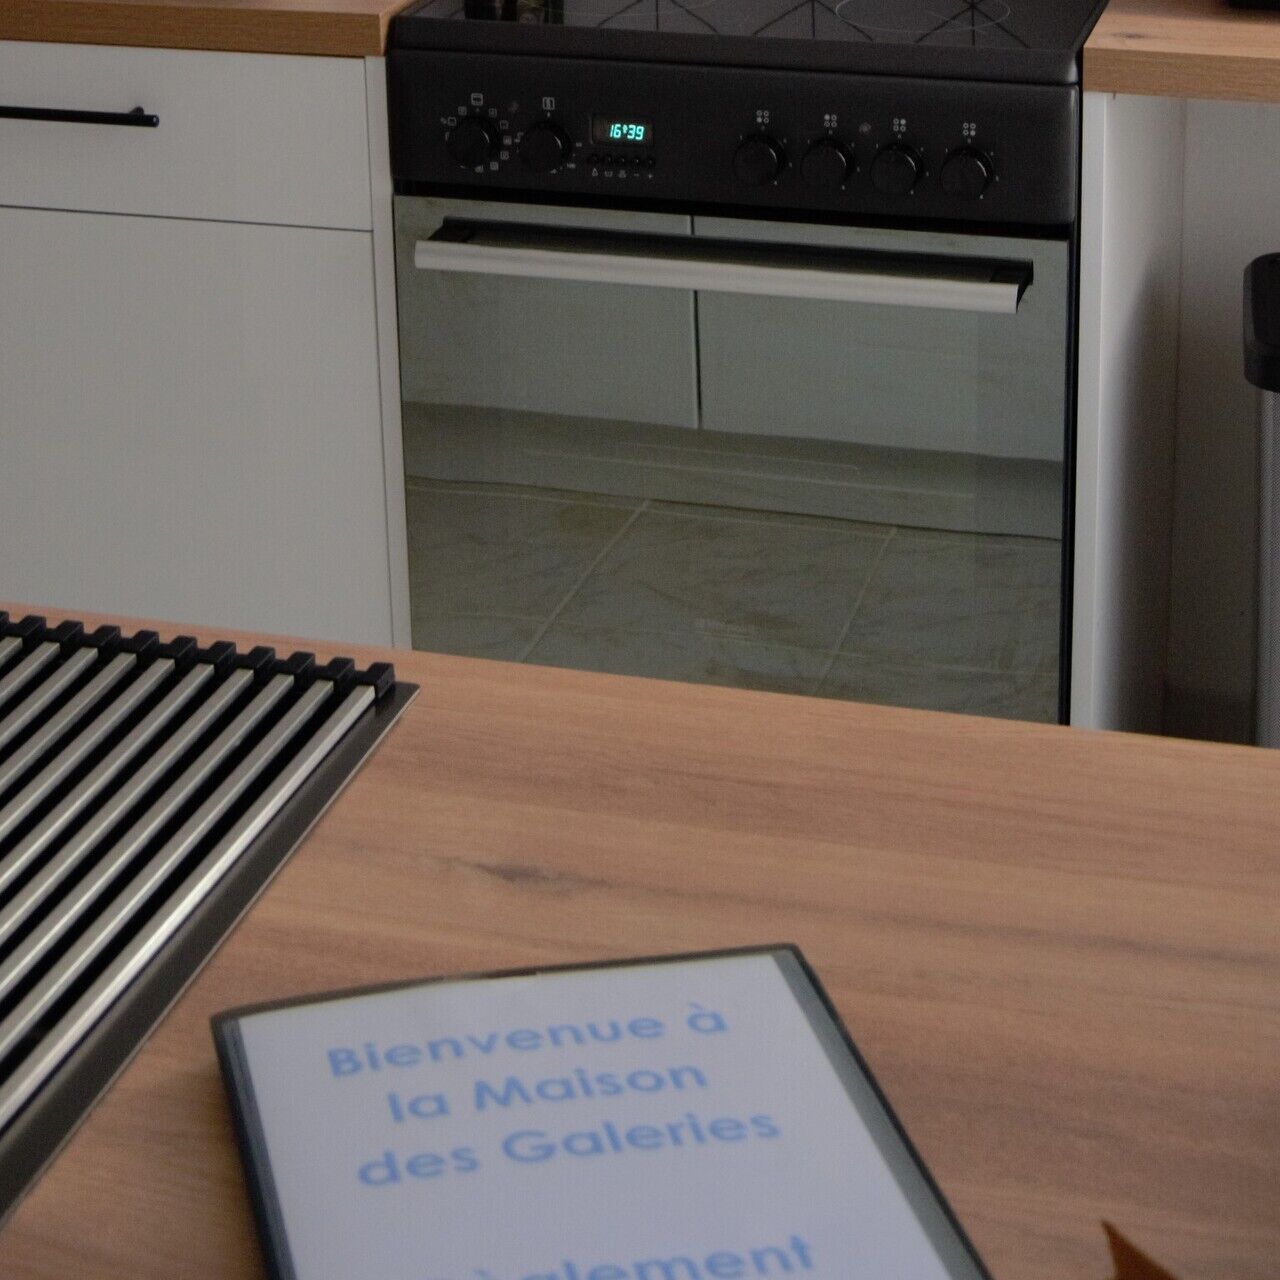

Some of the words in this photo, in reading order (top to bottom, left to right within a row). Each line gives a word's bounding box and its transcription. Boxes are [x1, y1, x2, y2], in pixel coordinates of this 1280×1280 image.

[326, 1014, 667, 1078] Bienvenue
[686, 1000, 728, 1035] à
[387, 1089, 451, 1123] la
[472, 1063, 709, 1113] Maison
[356, 1144, 481, 1188] des
[500, 1112, 782, 1164] Galeries
[472, 1233, 815, 1280] lement
